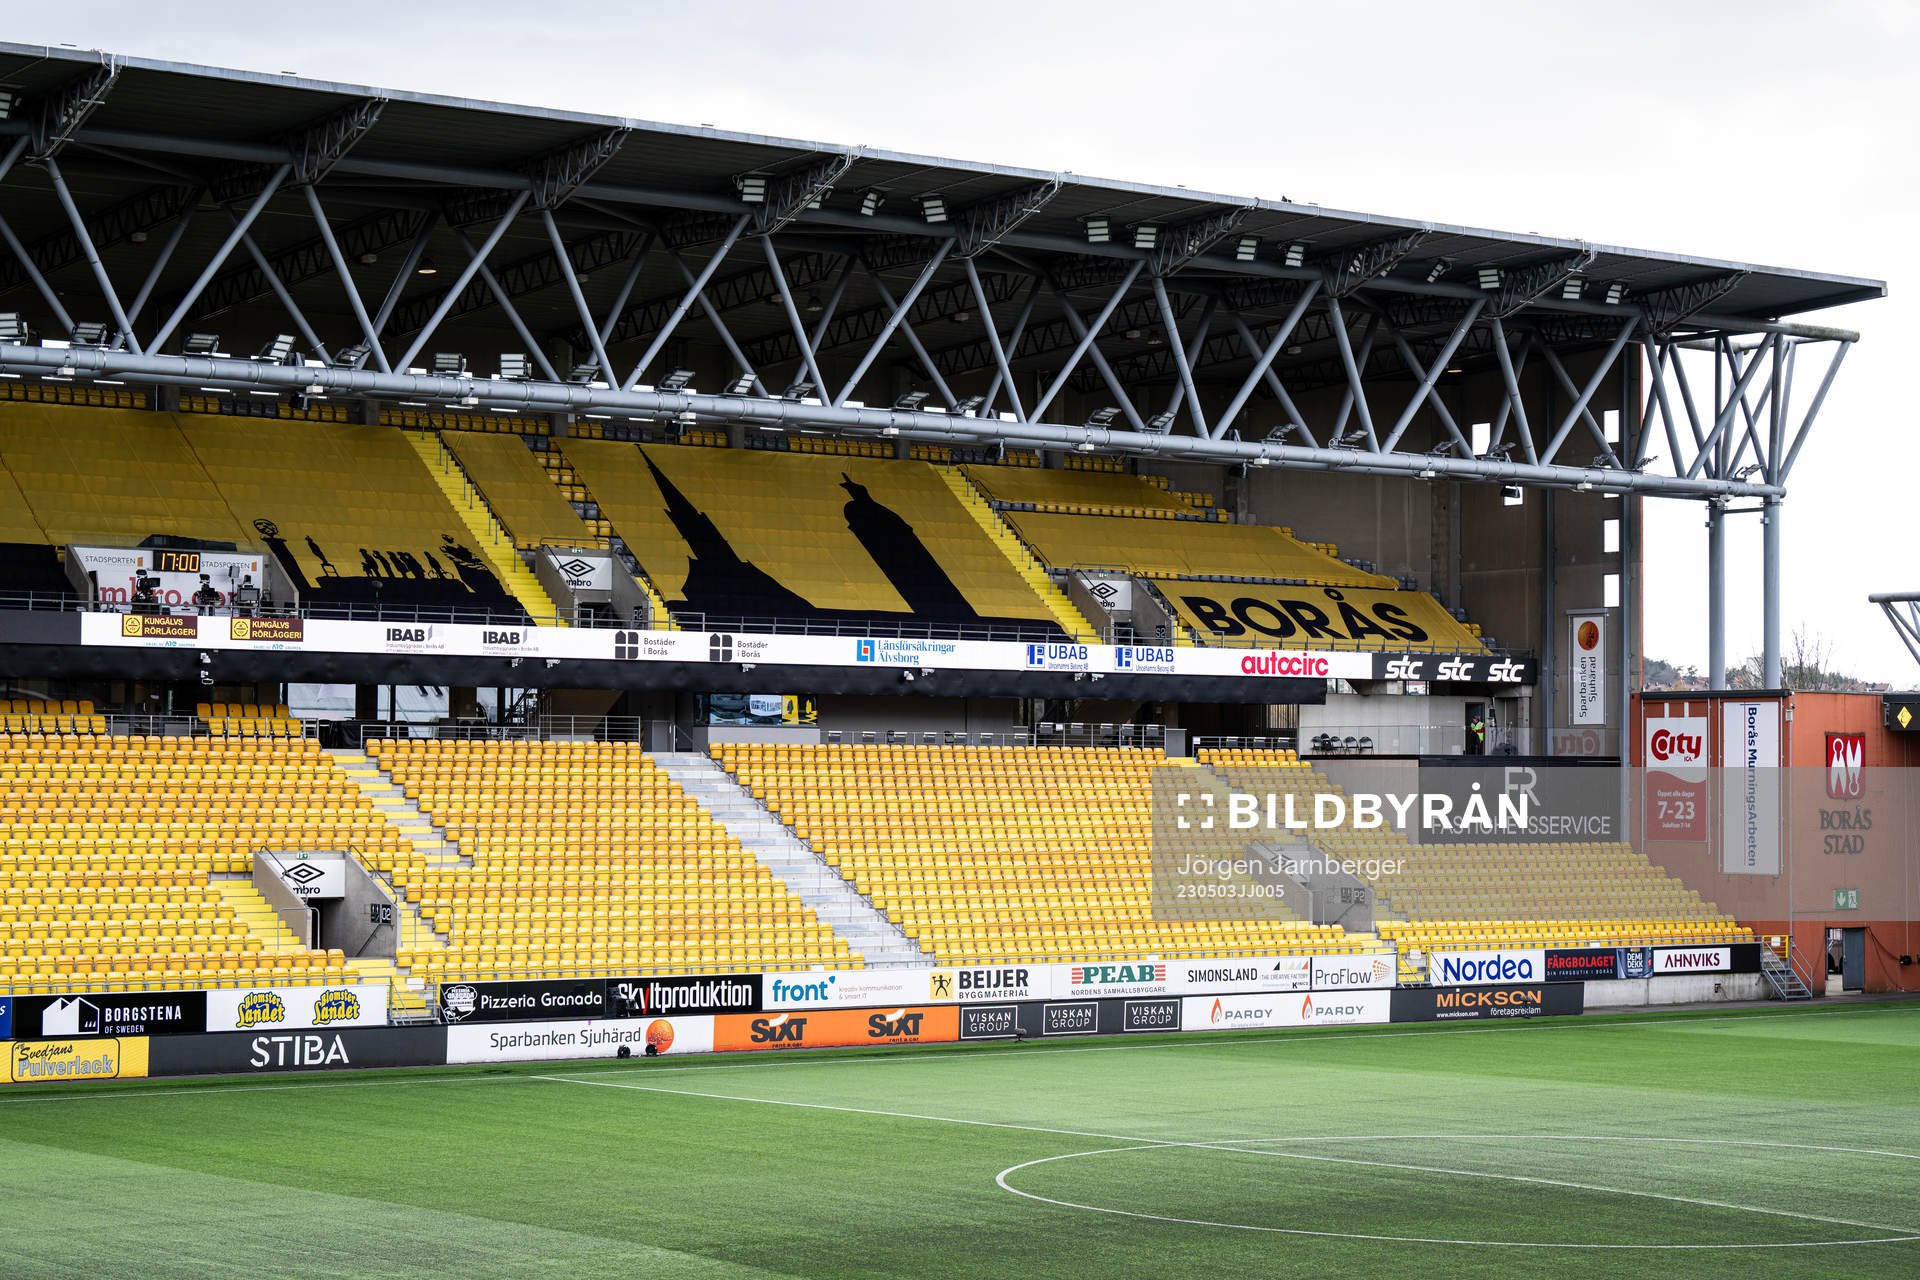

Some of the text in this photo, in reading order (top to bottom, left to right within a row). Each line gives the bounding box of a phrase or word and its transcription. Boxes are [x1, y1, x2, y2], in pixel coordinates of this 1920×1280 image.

[85, 556, 136, 566] STADSPORTEN
[162, 553, 200, 572] 17:00
[201, 560, 250, 569] STADSPORTEN
[144, 617, 183, 626] KUNGÄLVS
[1180, 588, 1428, 643] BORÅS
[144, 627, 196, 637] RÖRLÄGGERI
[252, 621, 290, 629] KUNGÄLVS
[1155, 627, 1166, 638] S2
[252, 630, 302, 639] RÖRLÄGGERI
[386, 628, 425, 642] IBAB
[483, 631, 520, 645] IBAB
[644, 637, 675, 646] Bostäder
[648, 647, 668, 656] Borås
[738, 640, 768, 649] Bostäder
[878, 640, 956, 654] Länsförsäkringar
[742, 650, 761, 658] Borås
[878, 650, 919, 665] Älvsborg
[1048, 645, 1088, 660] UBAB
[1136, 648, 1174, 662] UBAB
[1241, 652, 1328, 676] autocirc
[1385, 655, 1424, 679] stc
[1436, 657, 1475, 680] stc
[1487, 659, 1525, 682] stc
[1579, 656, 1588, 718] Sparbanken
[1588, 656, 1598, 703] Sjuhärad
[1748, 706, 1759, 747] Borås
[1651, 729, 1702, 761] City
[1658, 801, 1695, 819] 7-23
[1819, 805, 1872, 830] BORÅS
[1432, 816, 1610, 835] FSIGHESSERVICE
[1823, 834, 1865, 854] STAD
[1354, 890, 1365, 902] P2
[1547, 954, 1615, 969] FÄRGBOLAGET
[1627, 952, 1643, 961] DEMI
[1082, 964, 1156, 984] PEAB
[1187, 968, 1258, 983] SIMONSLAND
[1444, 954, 1532, 982] Nordea
[959, 969, 1029, 989] BEIJER
[1315, 968, 1372, 986] ProFlow
[320, 990, 357, 1006] Blomster
[618, 980, 752, 1014] Skyltproduktion
[773, 979, 828, 1002] front
[959, 990, 1029, 999] BYGGMATERIAL
[1071, 985, 1166, 996] NORDENS SAMHÄLLSBYGGARE
[244, 992, 282, 1008] Blomster
[481, 994, 536, 1009] Pizzeria
[541, 991, 602, 1007] Granada
[105, 1006, 182, 1023] BORGSTENA
[236, 1003, 286, 1028] Landet
[312, 1001, 361, 1025] Landet
[969, 1012, 1011, 1023] VISKAN
[1050, 1008, 1092, 1019] VISKAN
[1132, 1006, 1174, 1016] VISKAN
[1437, 1010, 1479, 1018] www.mickson.com
[1490, 1007, 1541, 1018] företagsreklam
[970, 1022, 1010, 1033] GROUP
[1052, 1018, 1091, 1029] GROUP
[1133, 1015, 1172, 1026] GROUP
[105, 1025, 144, 1034] OF SWEDEN
[490, 1027, 641, 1051] Sparbanken Sjuhärad
[18, 1044, 73, 1061] Svedjans
[251, 1034, 350, 1068] STIBA
[18, 1055, 113, 1077] Pulverlack
